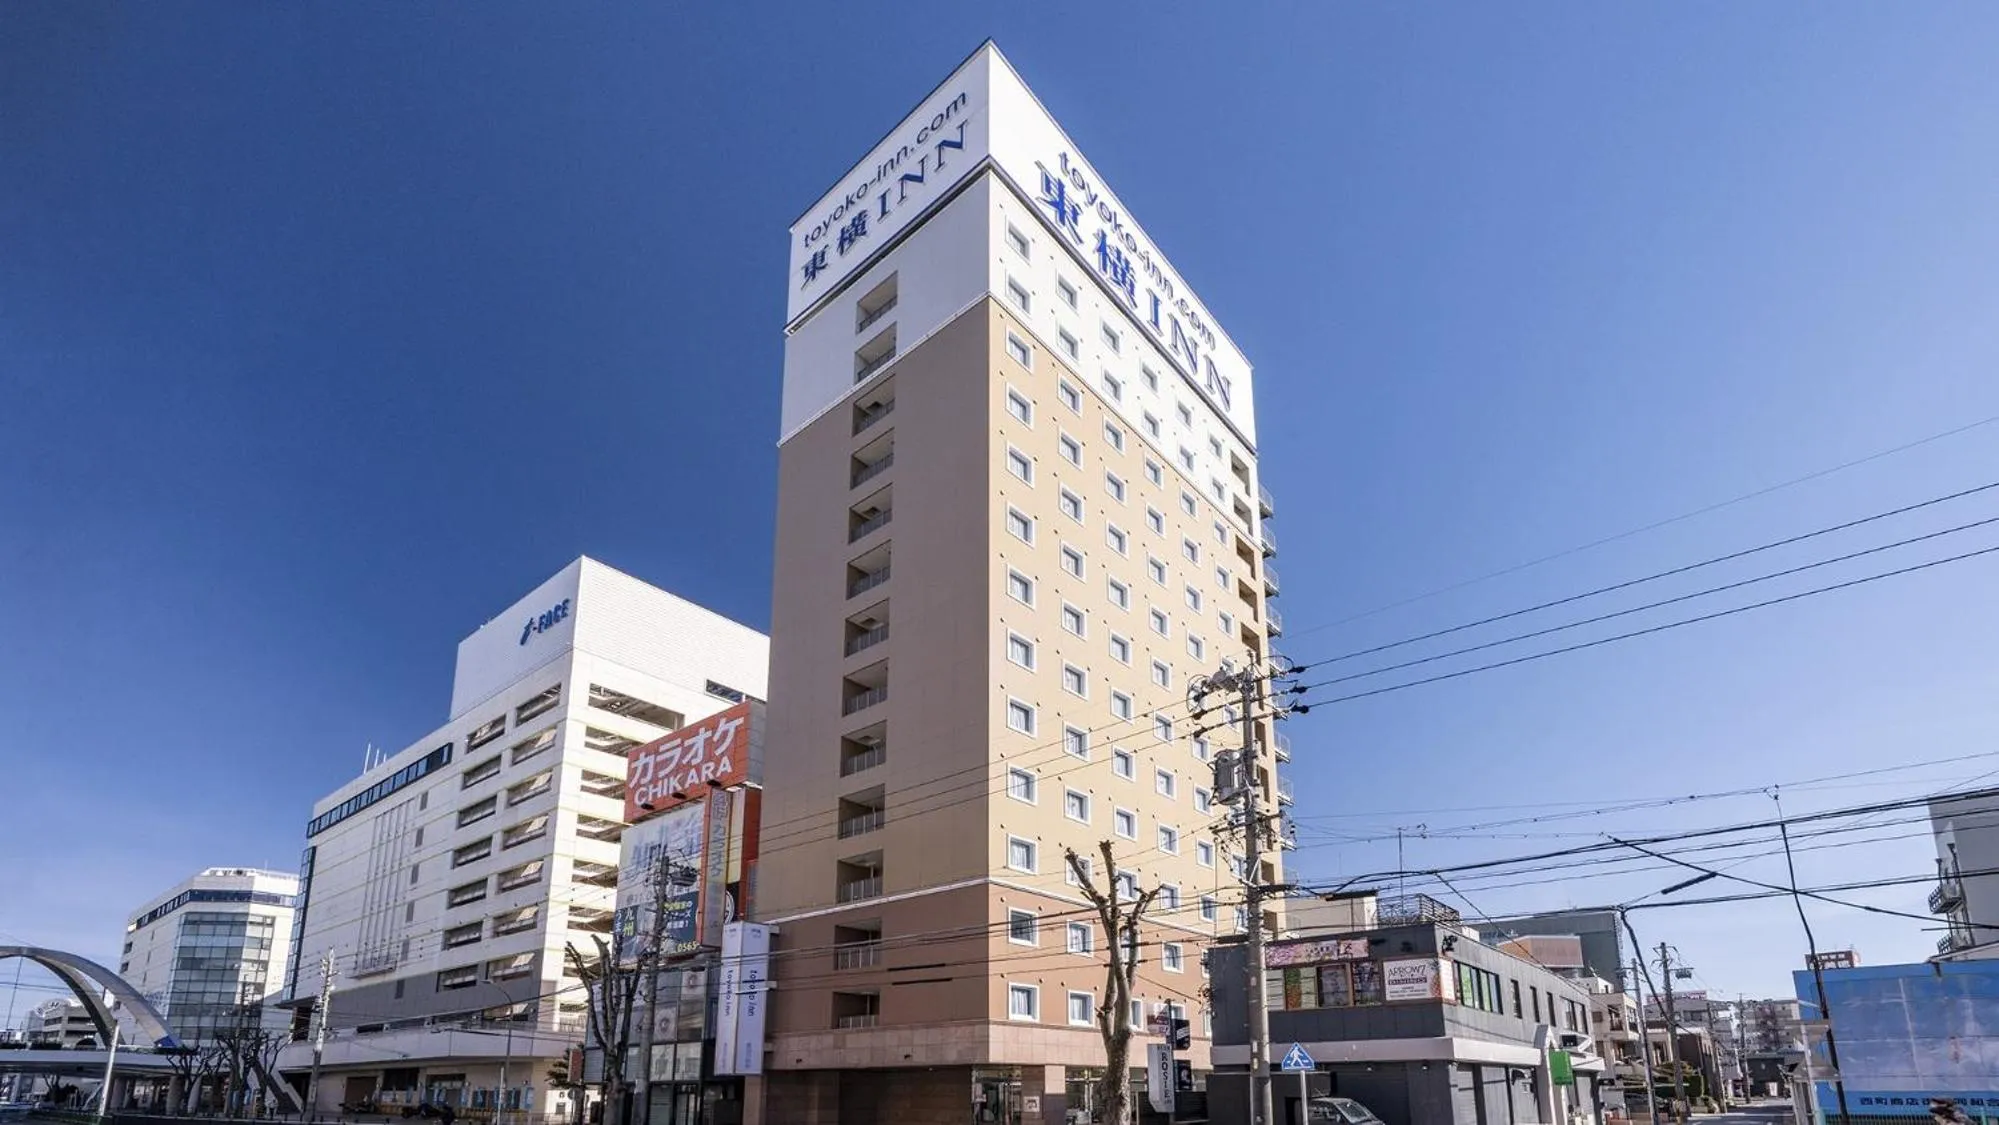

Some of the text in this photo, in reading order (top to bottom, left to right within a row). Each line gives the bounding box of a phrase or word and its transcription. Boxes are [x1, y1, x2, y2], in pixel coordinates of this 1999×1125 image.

[803, 92, 967, 248] toyoko-inn.com
[1058, 151, 1217, 351] toyoko-inn.com
[629, 717, 745, 789] カラオケ
[634, 756, 733, 806] CHIKARA
[1161, 1051, 1171, 1099] ROSIE
